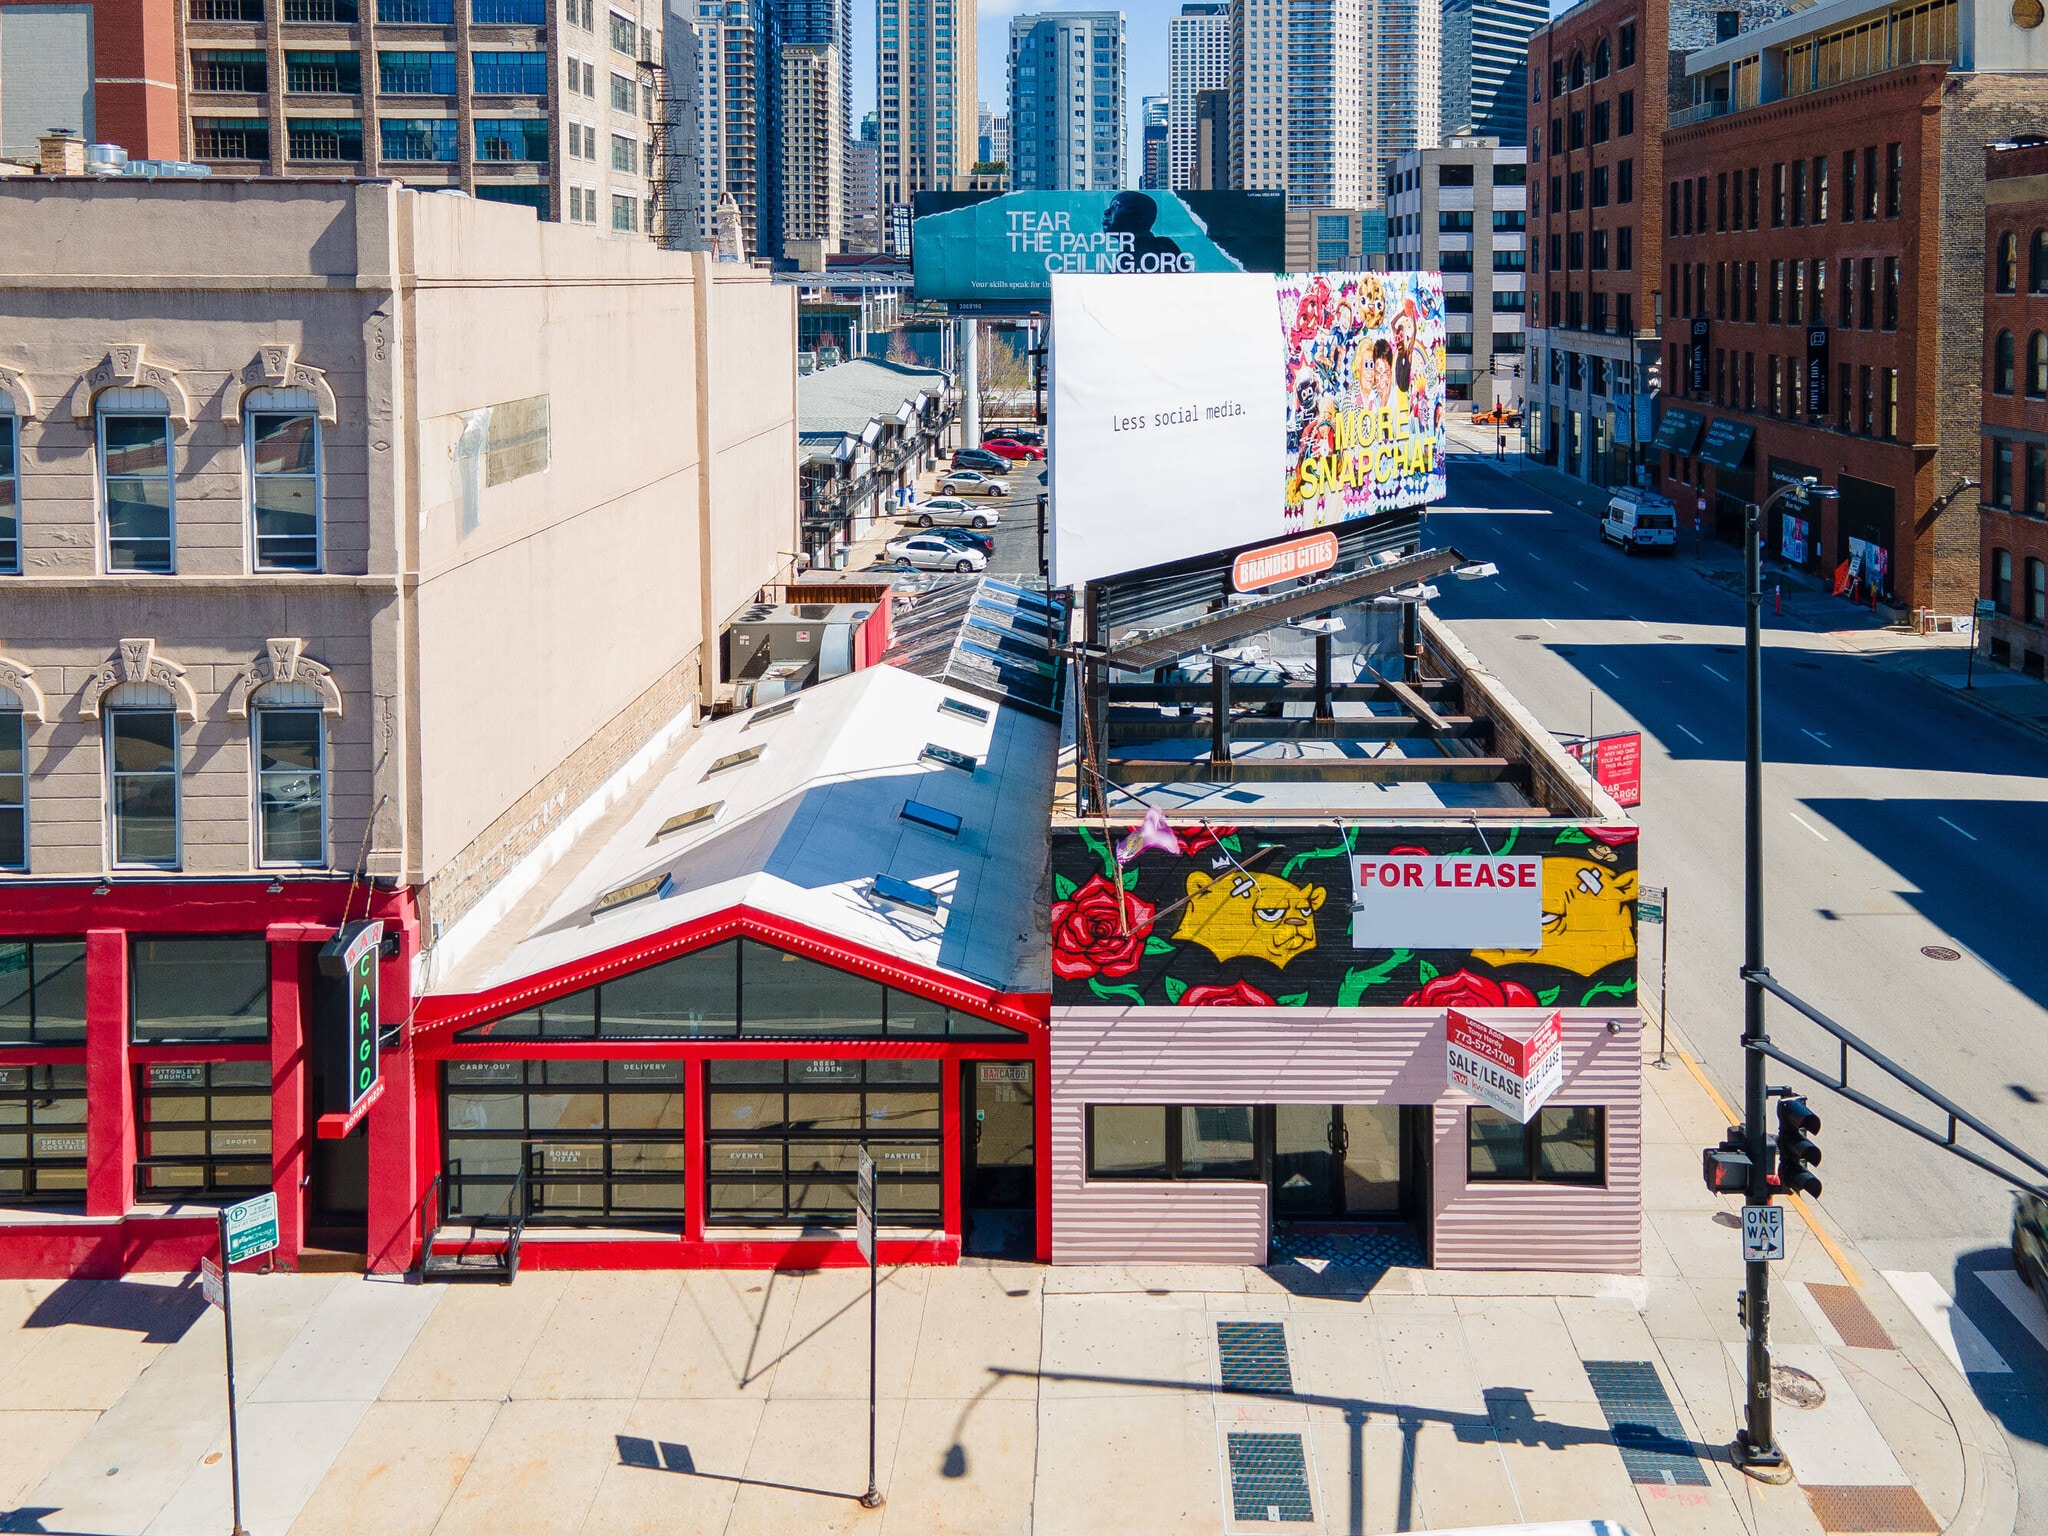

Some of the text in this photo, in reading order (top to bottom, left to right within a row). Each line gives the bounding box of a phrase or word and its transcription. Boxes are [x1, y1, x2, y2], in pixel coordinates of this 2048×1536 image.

[1006, 211, 1071, 231] TEAR
[1006, 232, 1135, 252] THE PAPER
[1044, 252, 1196, 273] CEILING.ORG
[971, 280, 988, 288] Your
[989, 280, 1008, 288] skills
[1009, 280, 1029, 290] speak
[1030, 280, 1041, 288] for
[1810, 359, 1819, 410] PAPER BOX
[1113, 400, 1246, 432] Less social media.
[1335, 404, 1410, 450] MORE
[1300, 437, 1436, 499] SNAPCHAT
[1240, 540, 1333, 585] BRANDED CITIES
[1608, 788, 1638, 799] ARGO
[1360, 863, 1536, 887] FOR LEASE
[349, 927, 380, 963] BAR
[359, 954, 371, 1090] CARGO
[1455, 1028, 1515, 1067] 773-572-1700
[1467, 1026, 1503, 1049] Tony Hardy
[1448, 1050, 1521, 1100] SALE/LEASE
[1453, 1071, 1468, 1086] KW
[345, 1084, 385, 1132] ROMAN PIZZA
[1747, 1211, 1778, 1224] ONE
[1747, 1226, 1779, 1239] WAY
